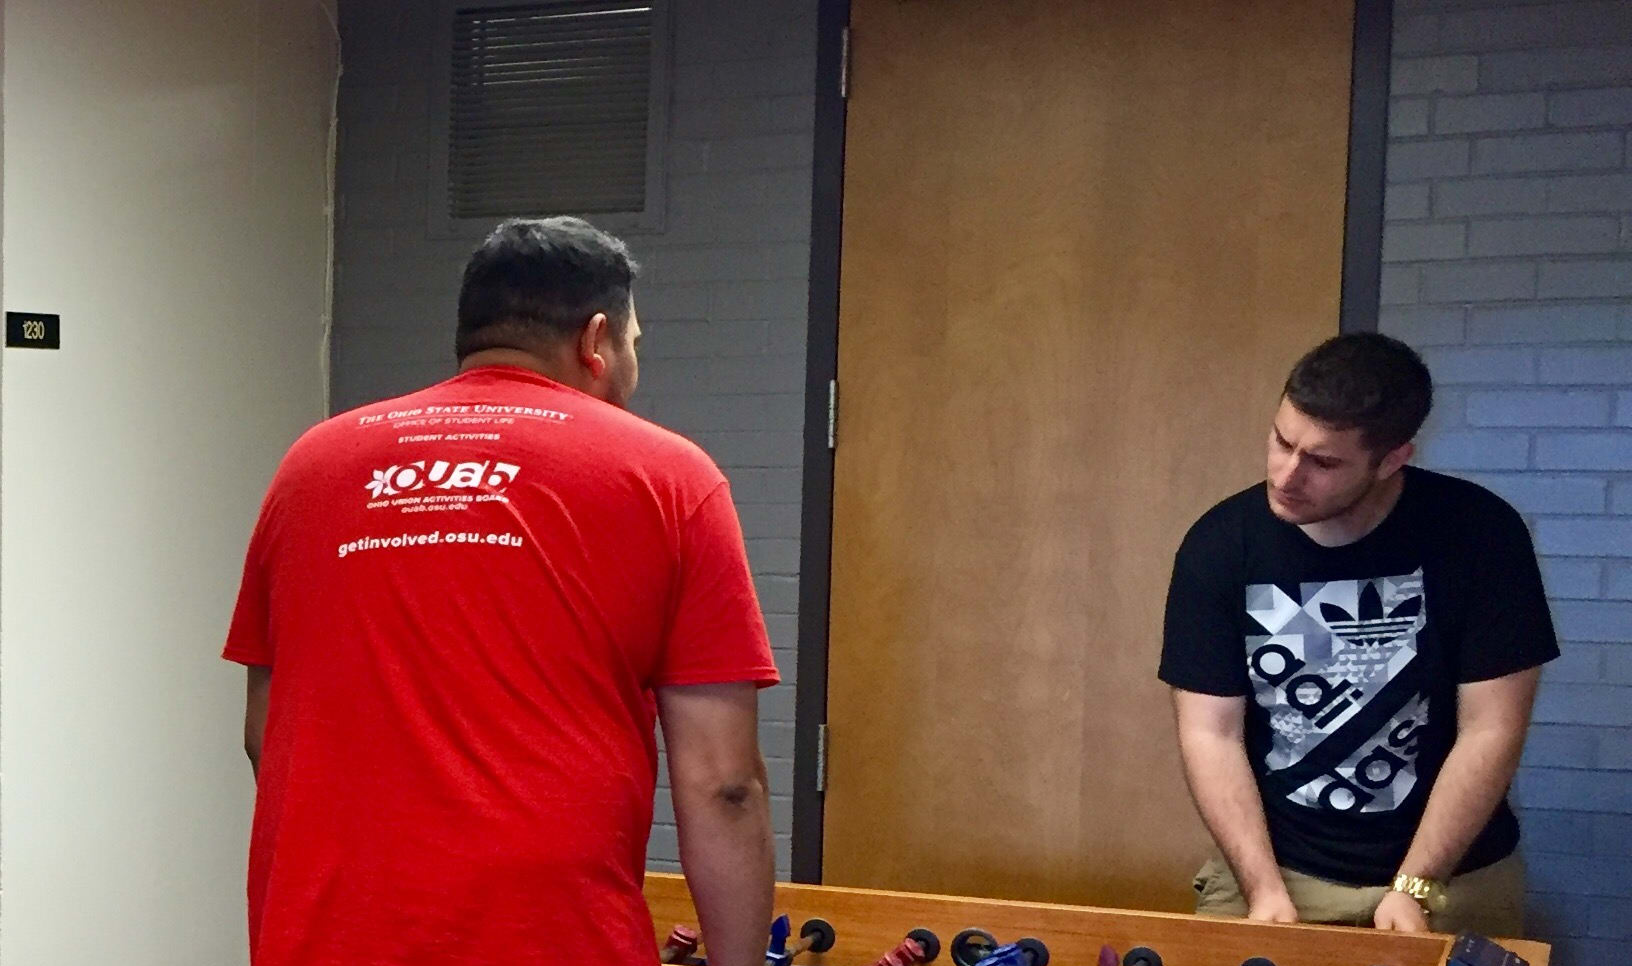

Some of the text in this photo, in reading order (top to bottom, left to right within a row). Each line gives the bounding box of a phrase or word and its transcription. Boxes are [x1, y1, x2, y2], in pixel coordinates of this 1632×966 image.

[23, 320, 45, 339] 1230
[358, 404, 569, 426] THE OHIO STATE UNIVERSITY
[397, 432, 501, 444] STUDENT ACTIVITIES
[423, 495, 473, 503] ACTIVITIES
[338, 530, 524, 558] getinvolved.osu.edu
